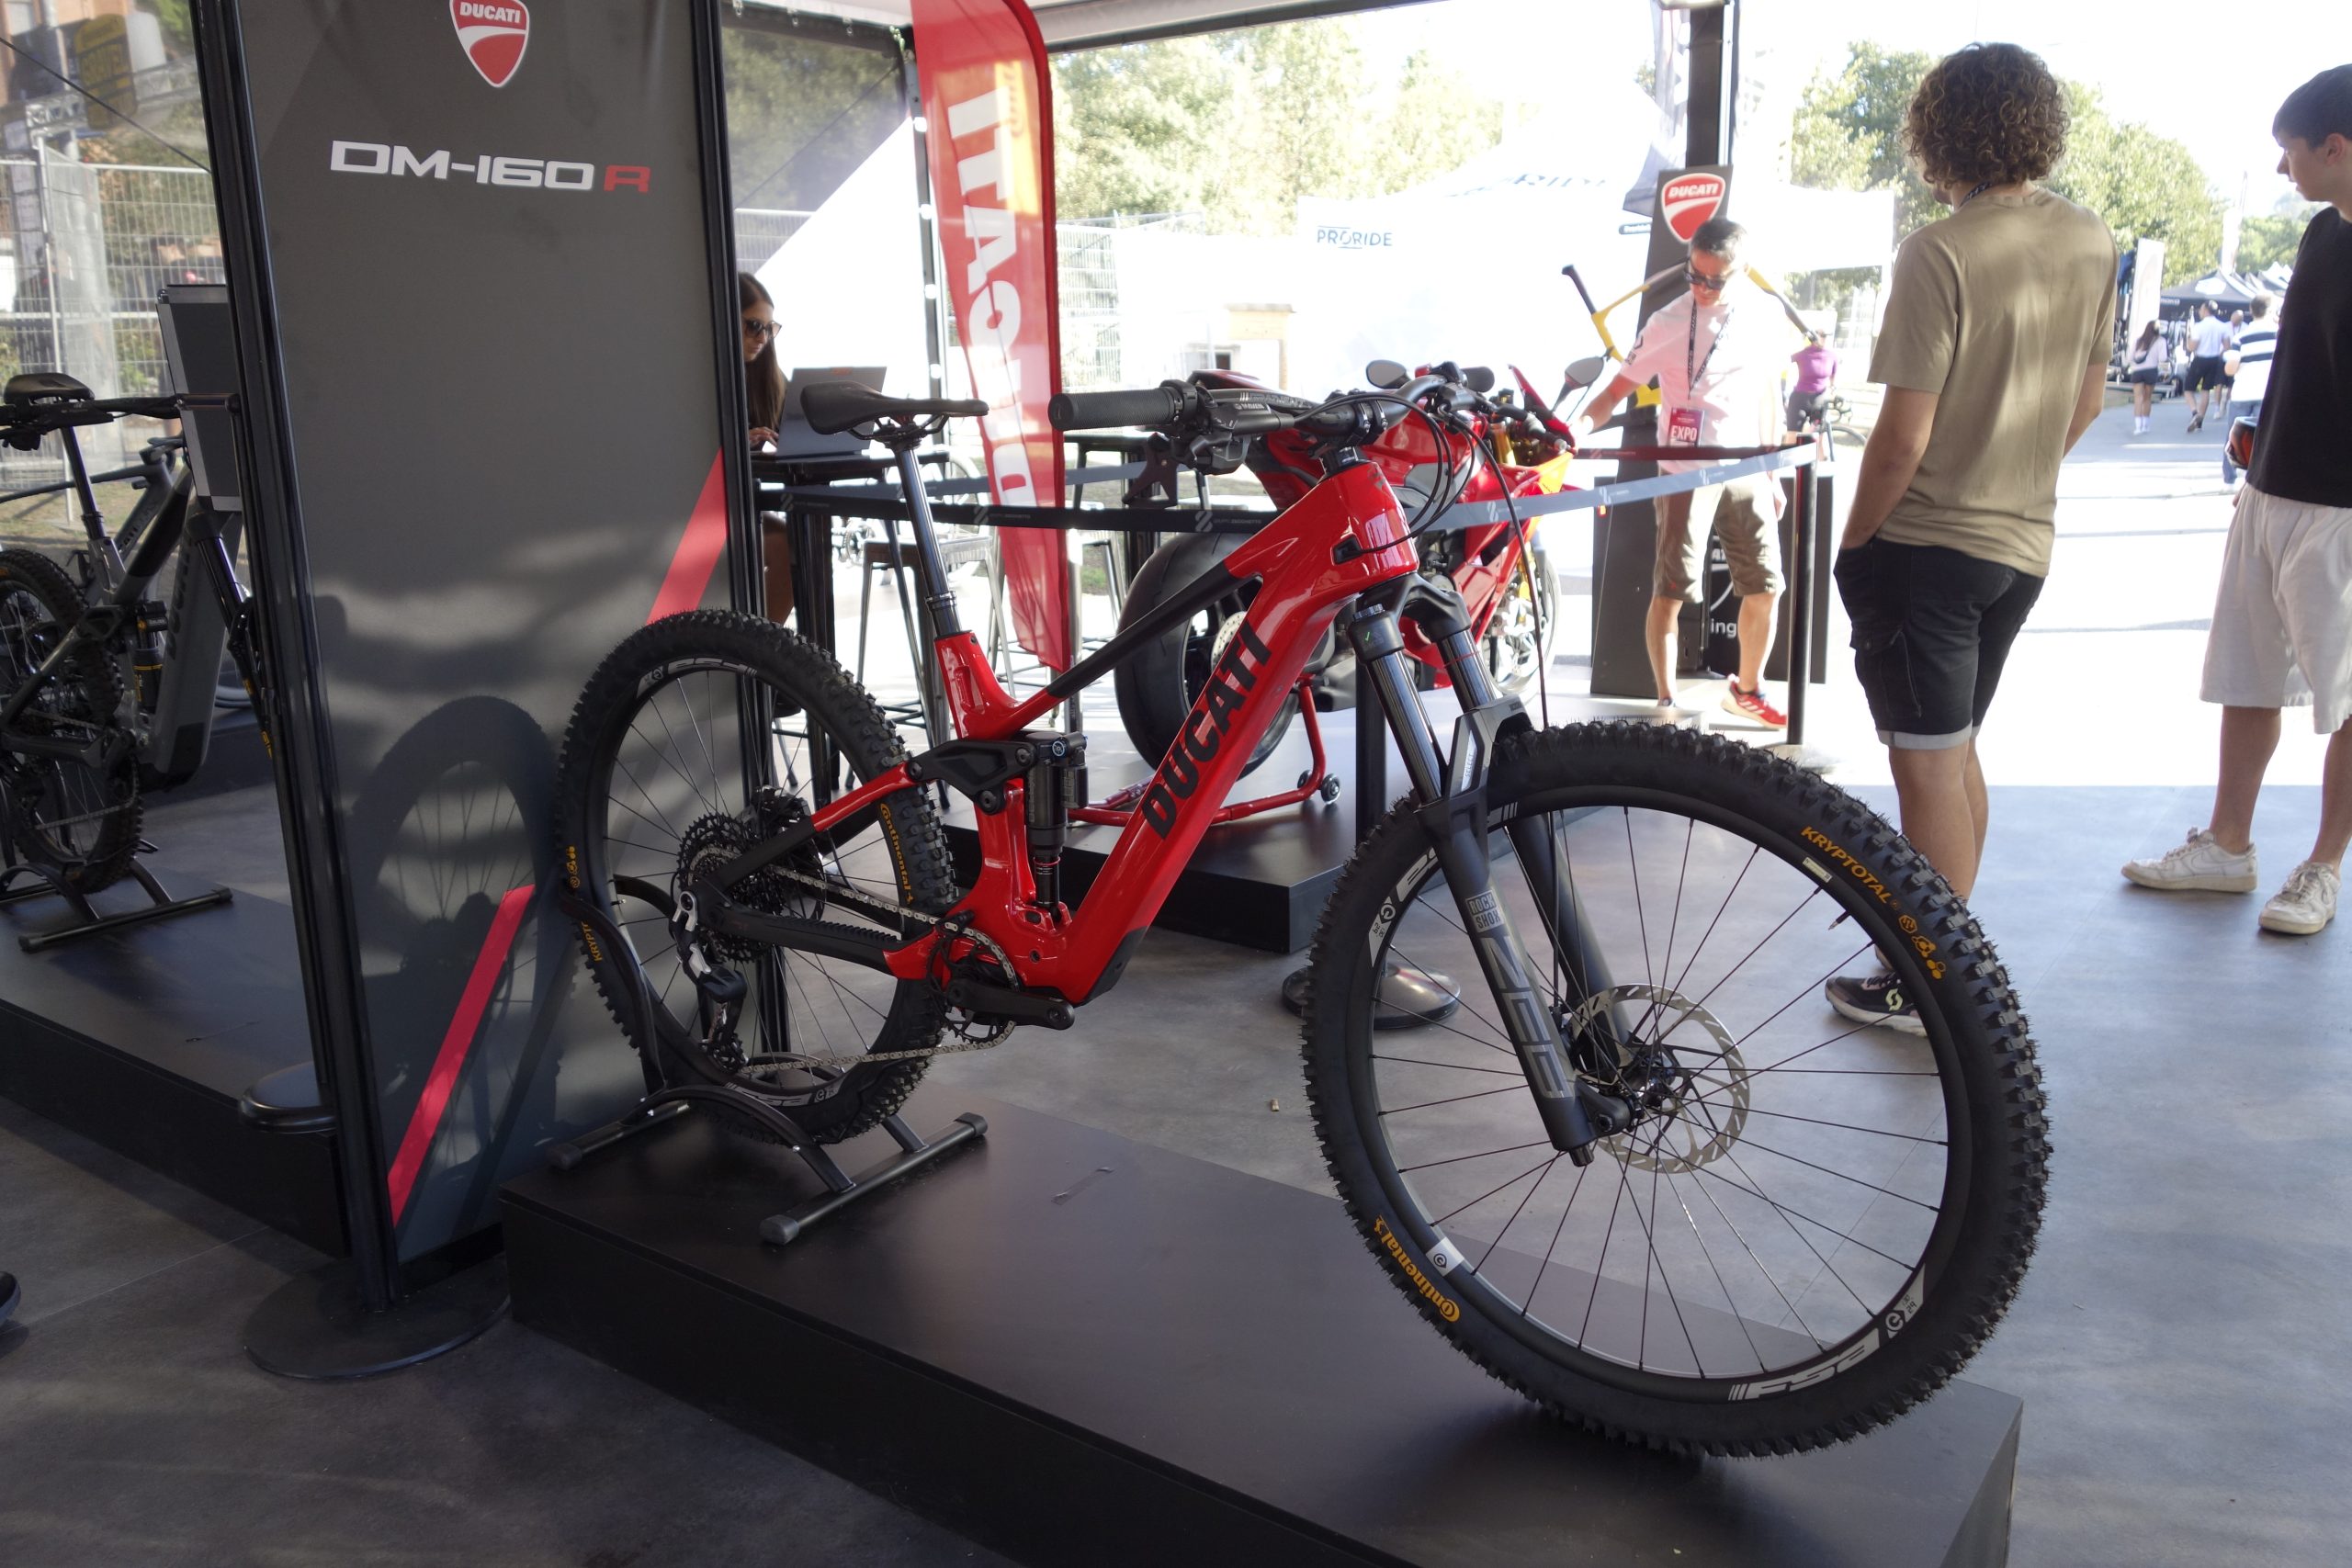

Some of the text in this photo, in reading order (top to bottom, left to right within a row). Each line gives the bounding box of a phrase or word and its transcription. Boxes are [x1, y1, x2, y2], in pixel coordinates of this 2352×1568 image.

[459, 2, 521, 24] DUCATI
[330, 140, 651, 193] DM-160 R
[1668, 183, 1719, 199] DUCATI
[1317, 229, 1394, 247] PRORIDE
[947, 85, 1035, 506] DUCATI
[1670, 424, 1698, 441] EXPO
[1710, 619, 1737, 639] ing
[1141, 621, 1272, 840] DUCATI
[880, 802, 911, 891] Continental
[1801, 826, 1894, 905] KRYPTOTAL
[1468, 892, 1497, 915] ROCK
[1475, 908, 1501, 929] SHOX
[580, 920, 604, 963] KRYPT
[1379, 1231, 1461, 1323] Continental
